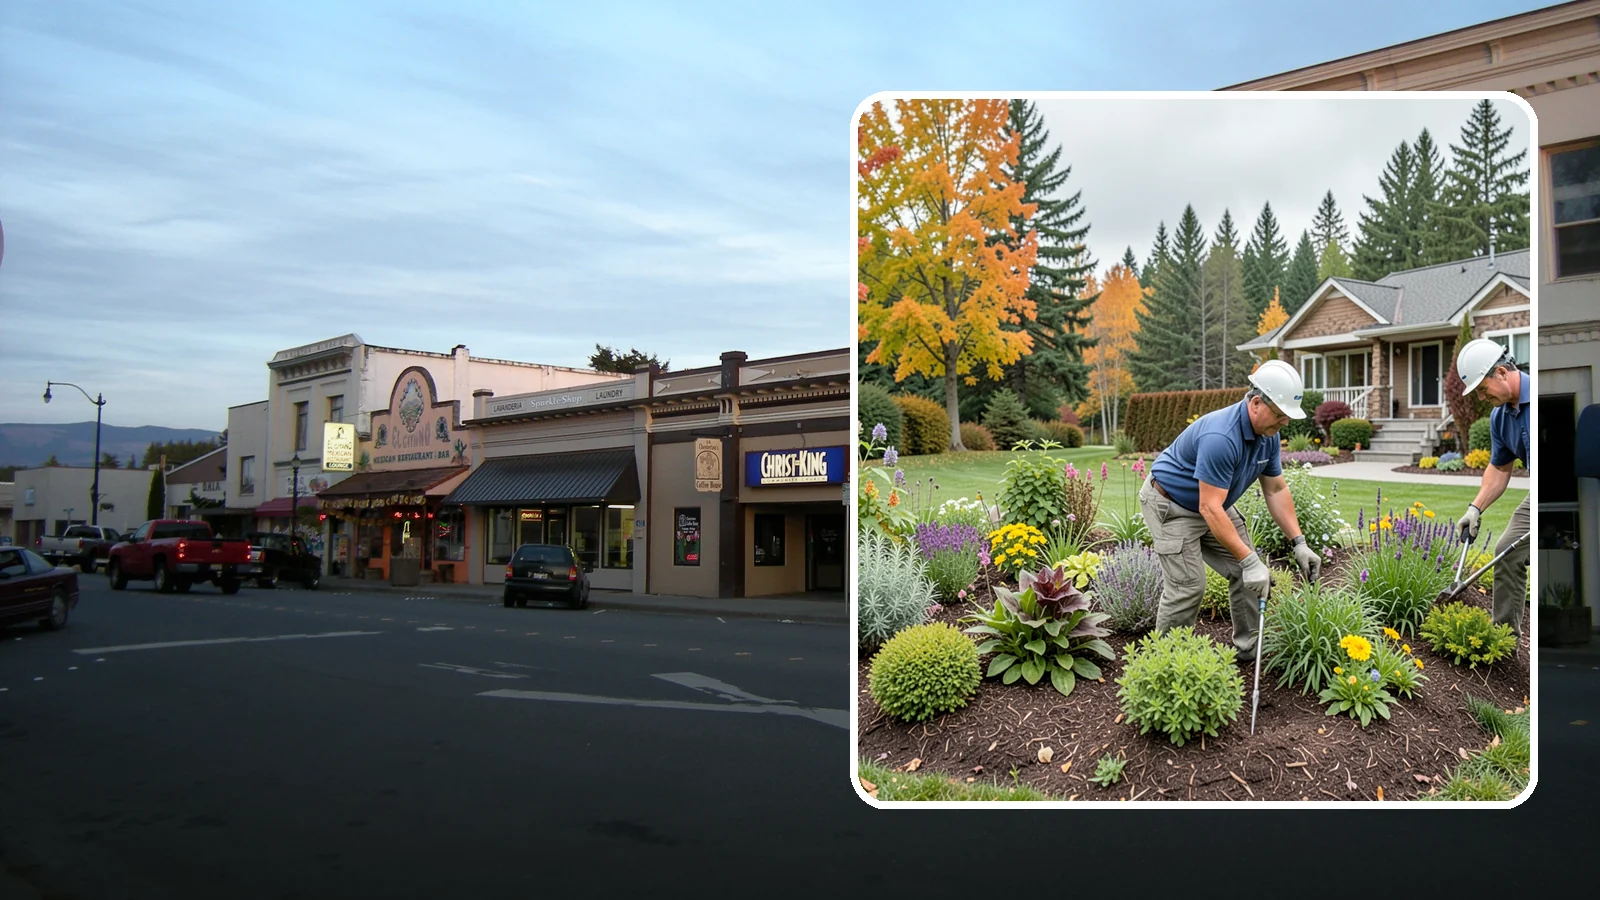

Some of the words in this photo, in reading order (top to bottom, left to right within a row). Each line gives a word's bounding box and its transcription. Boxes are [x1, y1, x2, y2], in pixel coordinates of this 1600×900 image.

[595, 389, 624, 400] LAUNDRY
[493, 402, 523, 413] LAVANDERIA
[530, 398, 561, 410] Sparkle
[561, 394, 582, 406] Shop
[373, 455, 396, 464] MEXICAN
[397, 451, 434, 462] RESTAURANT
[438, 450, 450, 459] BAR
